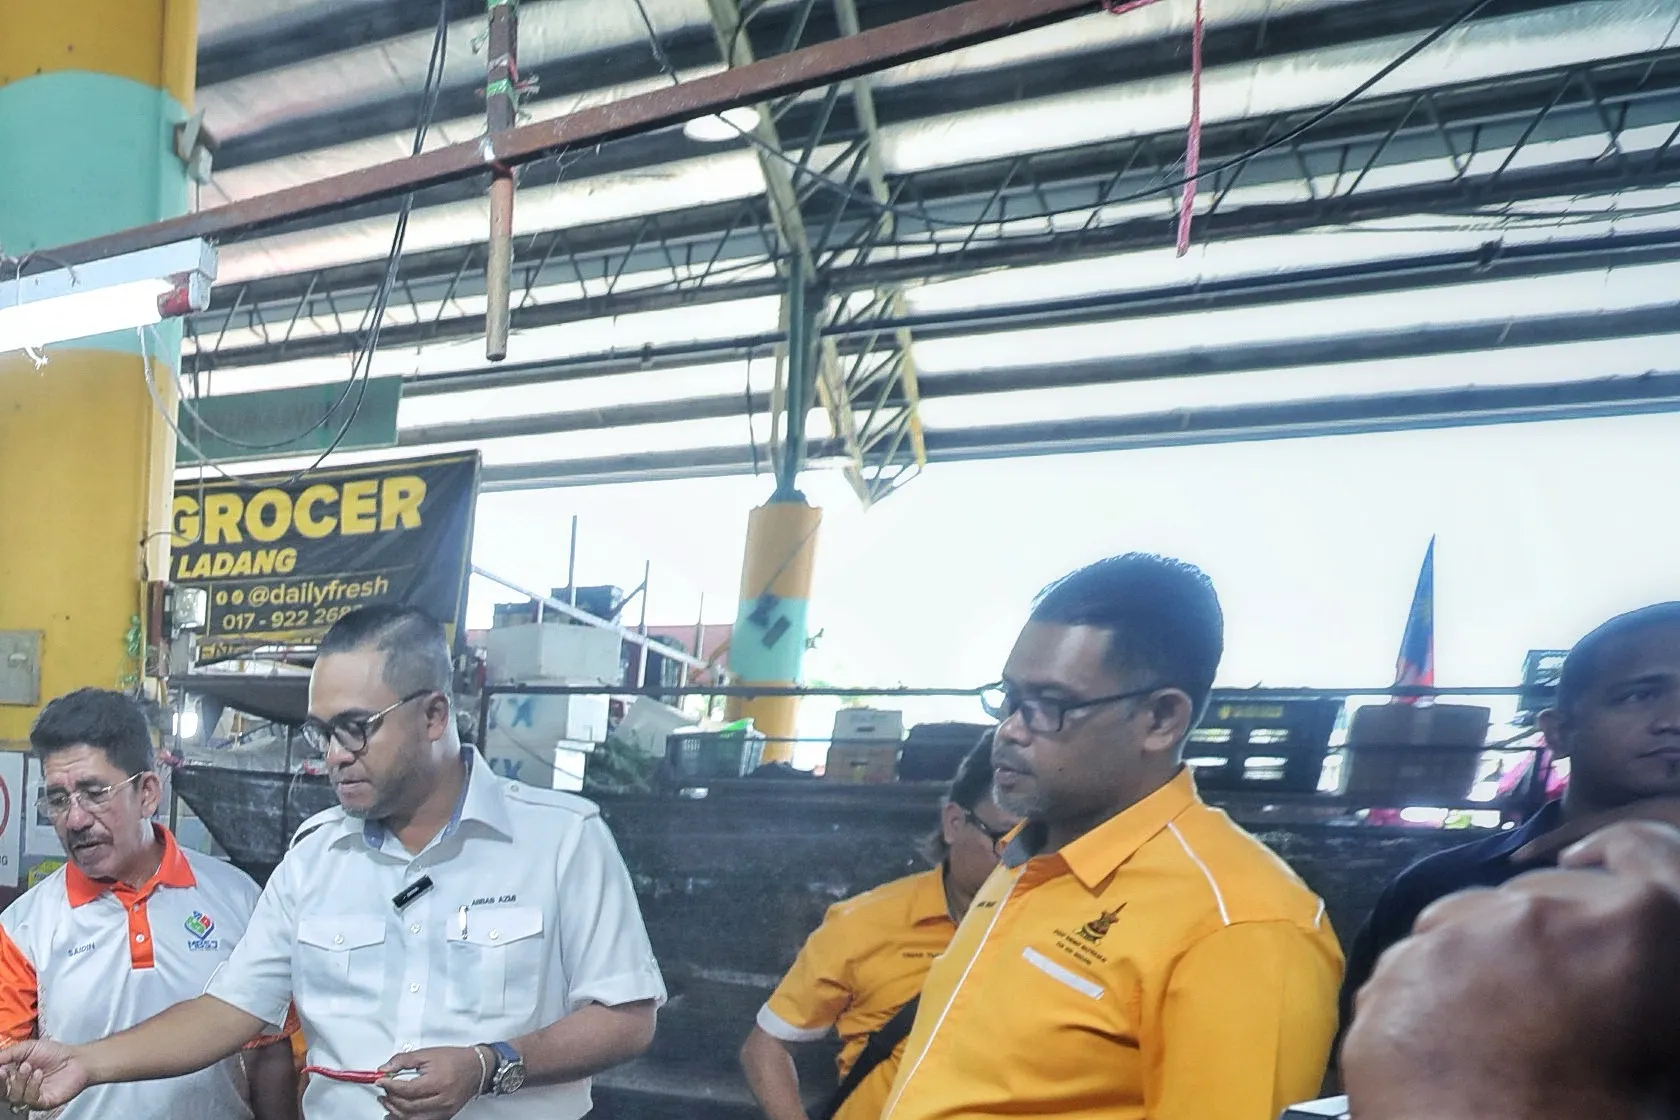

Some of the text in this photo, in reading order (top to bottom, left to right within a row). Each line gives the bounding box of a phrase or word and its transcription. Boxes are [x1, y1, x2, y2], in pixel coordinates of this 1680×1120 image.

[170, 475, 427, 548] GROCER
[177, 547, 297, 580] LADANG
[248, 575, 389, 607] @dailyfresh
[222, 613, 256, 630] 017
[271, 610, 309, 629] 922
